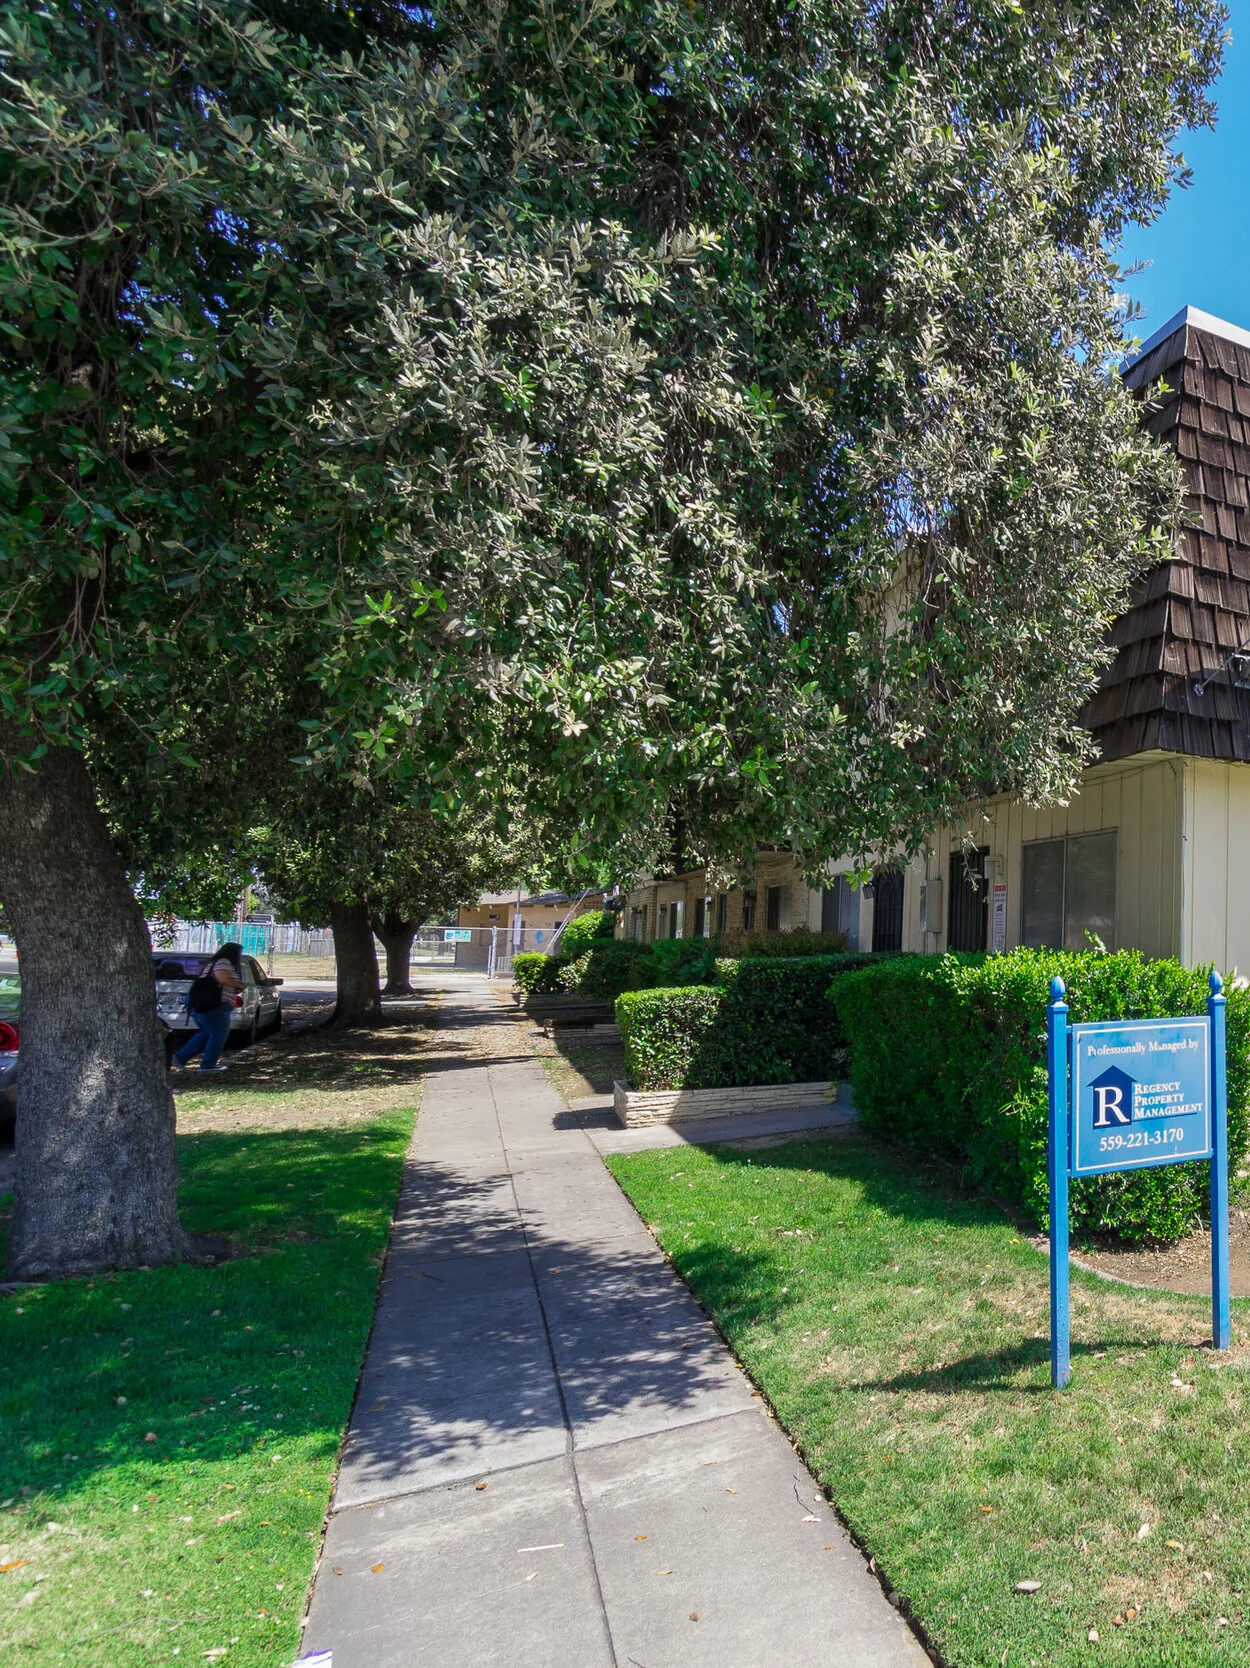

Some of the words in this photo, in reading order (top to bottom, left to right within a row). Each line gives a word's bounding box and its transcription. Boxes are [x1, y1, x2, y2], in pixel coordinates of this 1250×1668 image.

[1188, 1038, 1199, 1052] by
[1134, 1081, 1181, 1095] REGENCY
[1094, 1086, 1131, 1127] R
[1134, 1093, 1184, 1107] PROPERTY
[1134, 1102, 1203, 1120] MANAGEMENT
[1100, 1127, 1184, 1152] 559-221-3170
